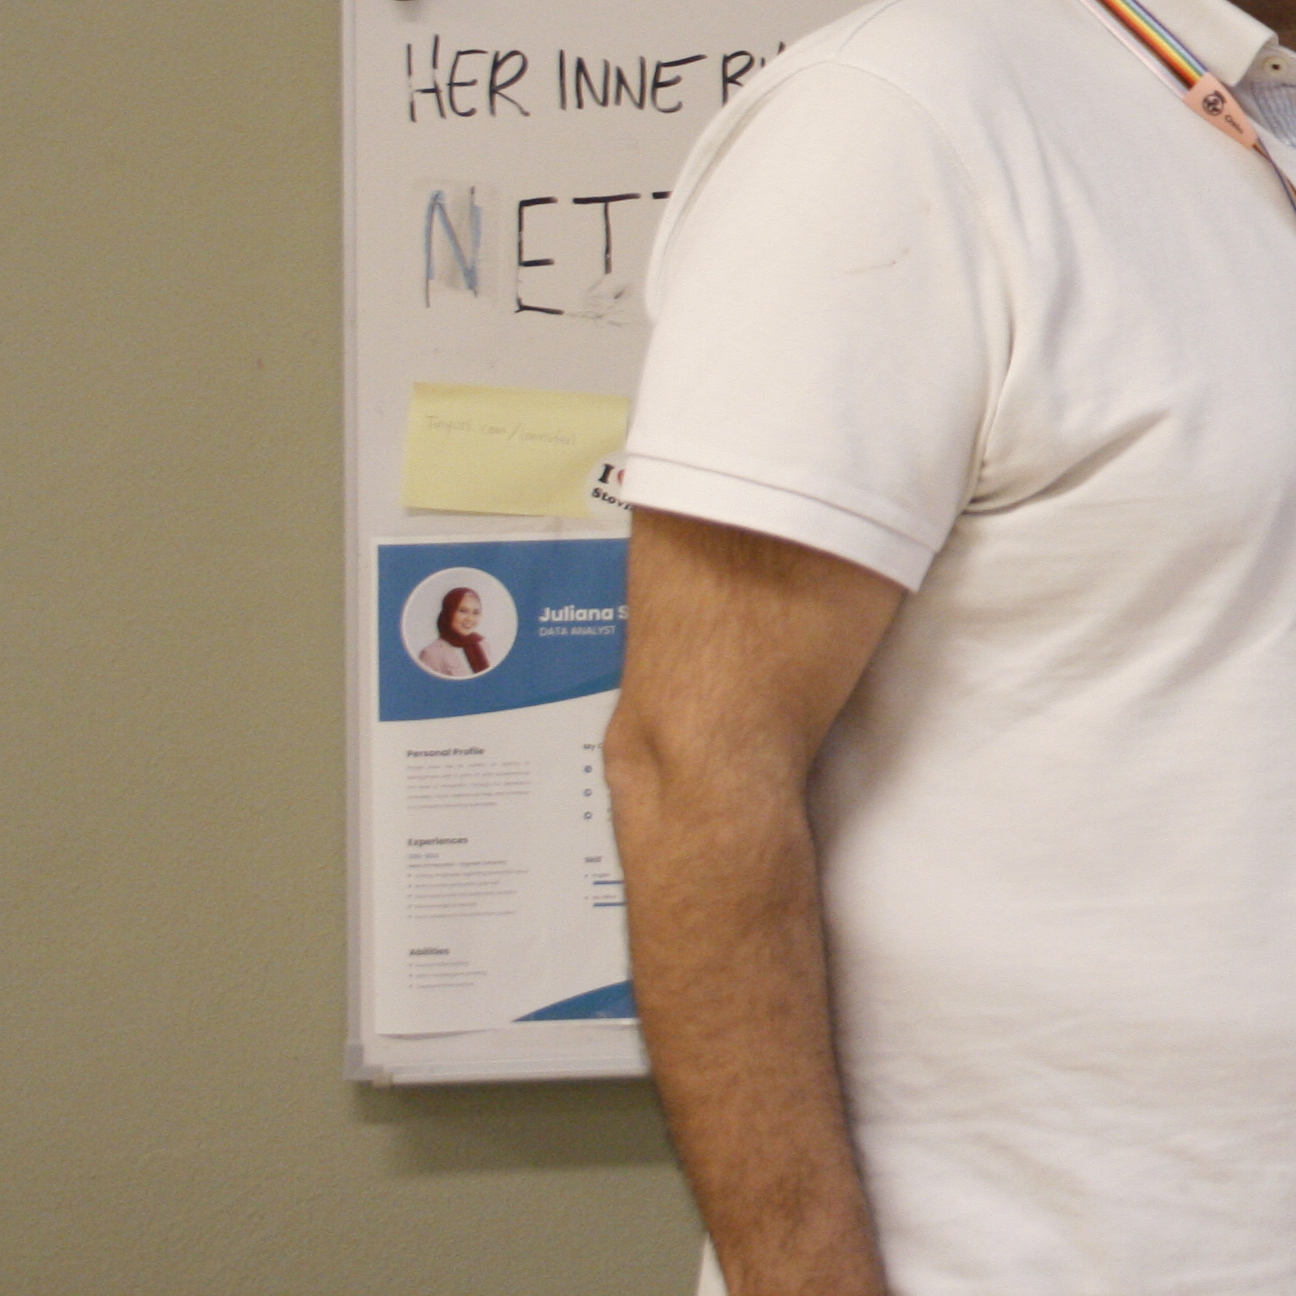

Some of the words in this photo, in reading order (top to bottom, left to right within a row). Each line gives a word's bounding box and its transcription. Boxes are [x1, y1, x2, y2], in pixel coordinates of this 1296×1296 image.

[406, 33, 531, 122] HER
[557, 48, 709, 114] INNE
[423, 184, 674, 317] NET
[538, 604, 614, 623] Juliana
